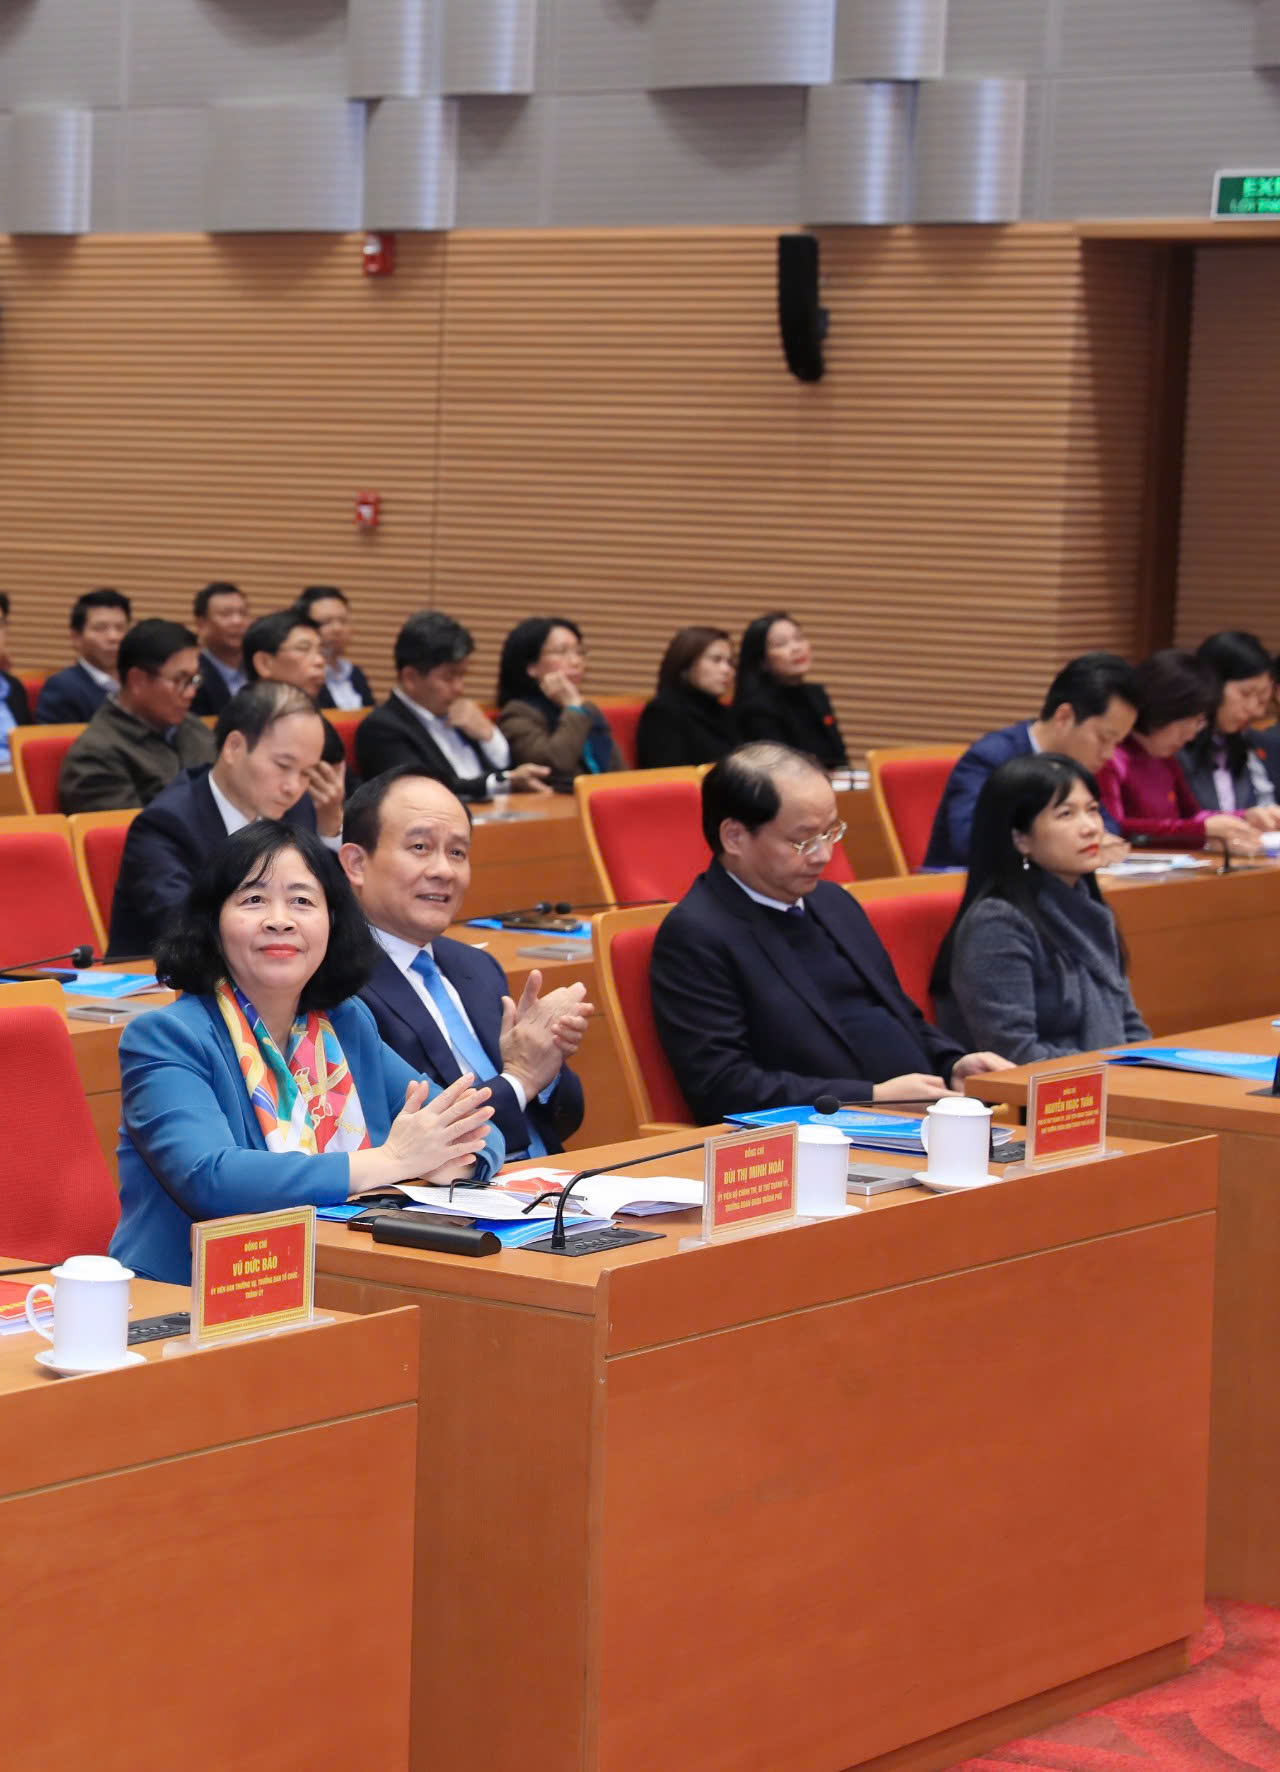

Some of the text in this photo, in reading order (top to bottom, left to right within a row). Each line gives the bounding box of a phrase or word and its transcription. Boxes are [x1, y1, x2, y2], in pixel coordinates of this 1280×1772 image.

[724, 1158, 784, 1185] BÙI THỊ MINH HOÀI
[232, 1251, 278, 1276] VŨ ĐỨC BẢO
